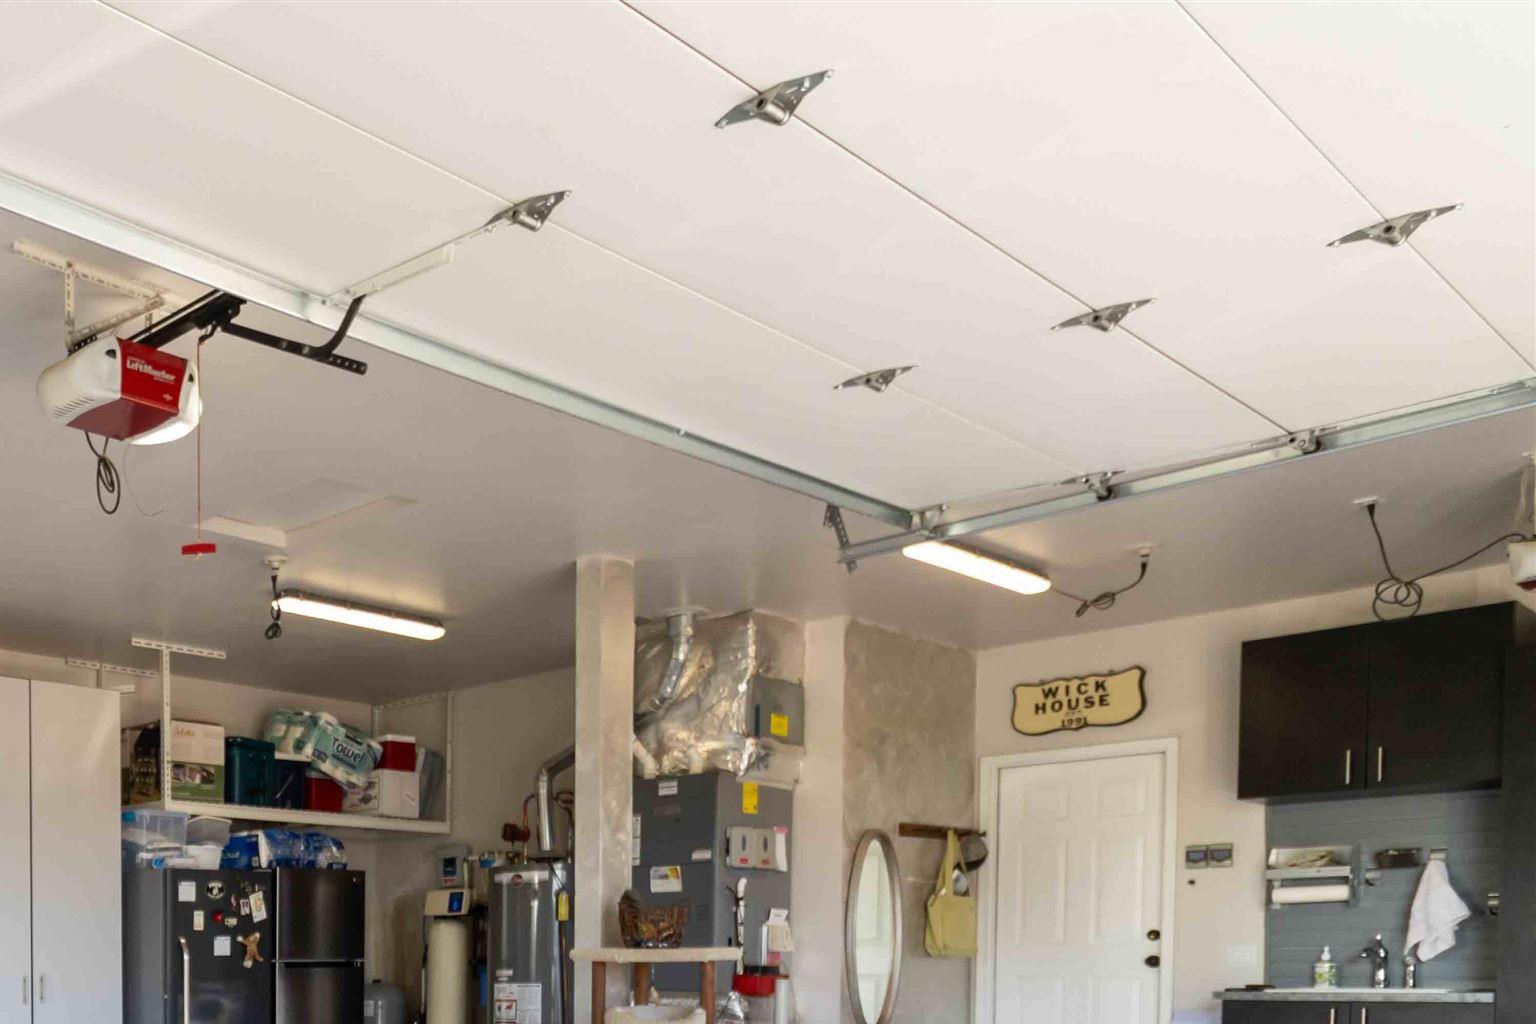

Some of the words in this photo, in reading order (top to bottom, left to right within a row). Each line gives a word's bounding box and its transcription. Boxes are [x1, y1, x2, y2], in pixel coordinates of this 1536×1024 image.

[126, 358, 176, 381] LiftMaster
[1041, 680, 1108, 700] WICK
[1034, 694, 1110, 716] HOUSE
[331, 736, 366, 763] Towel
